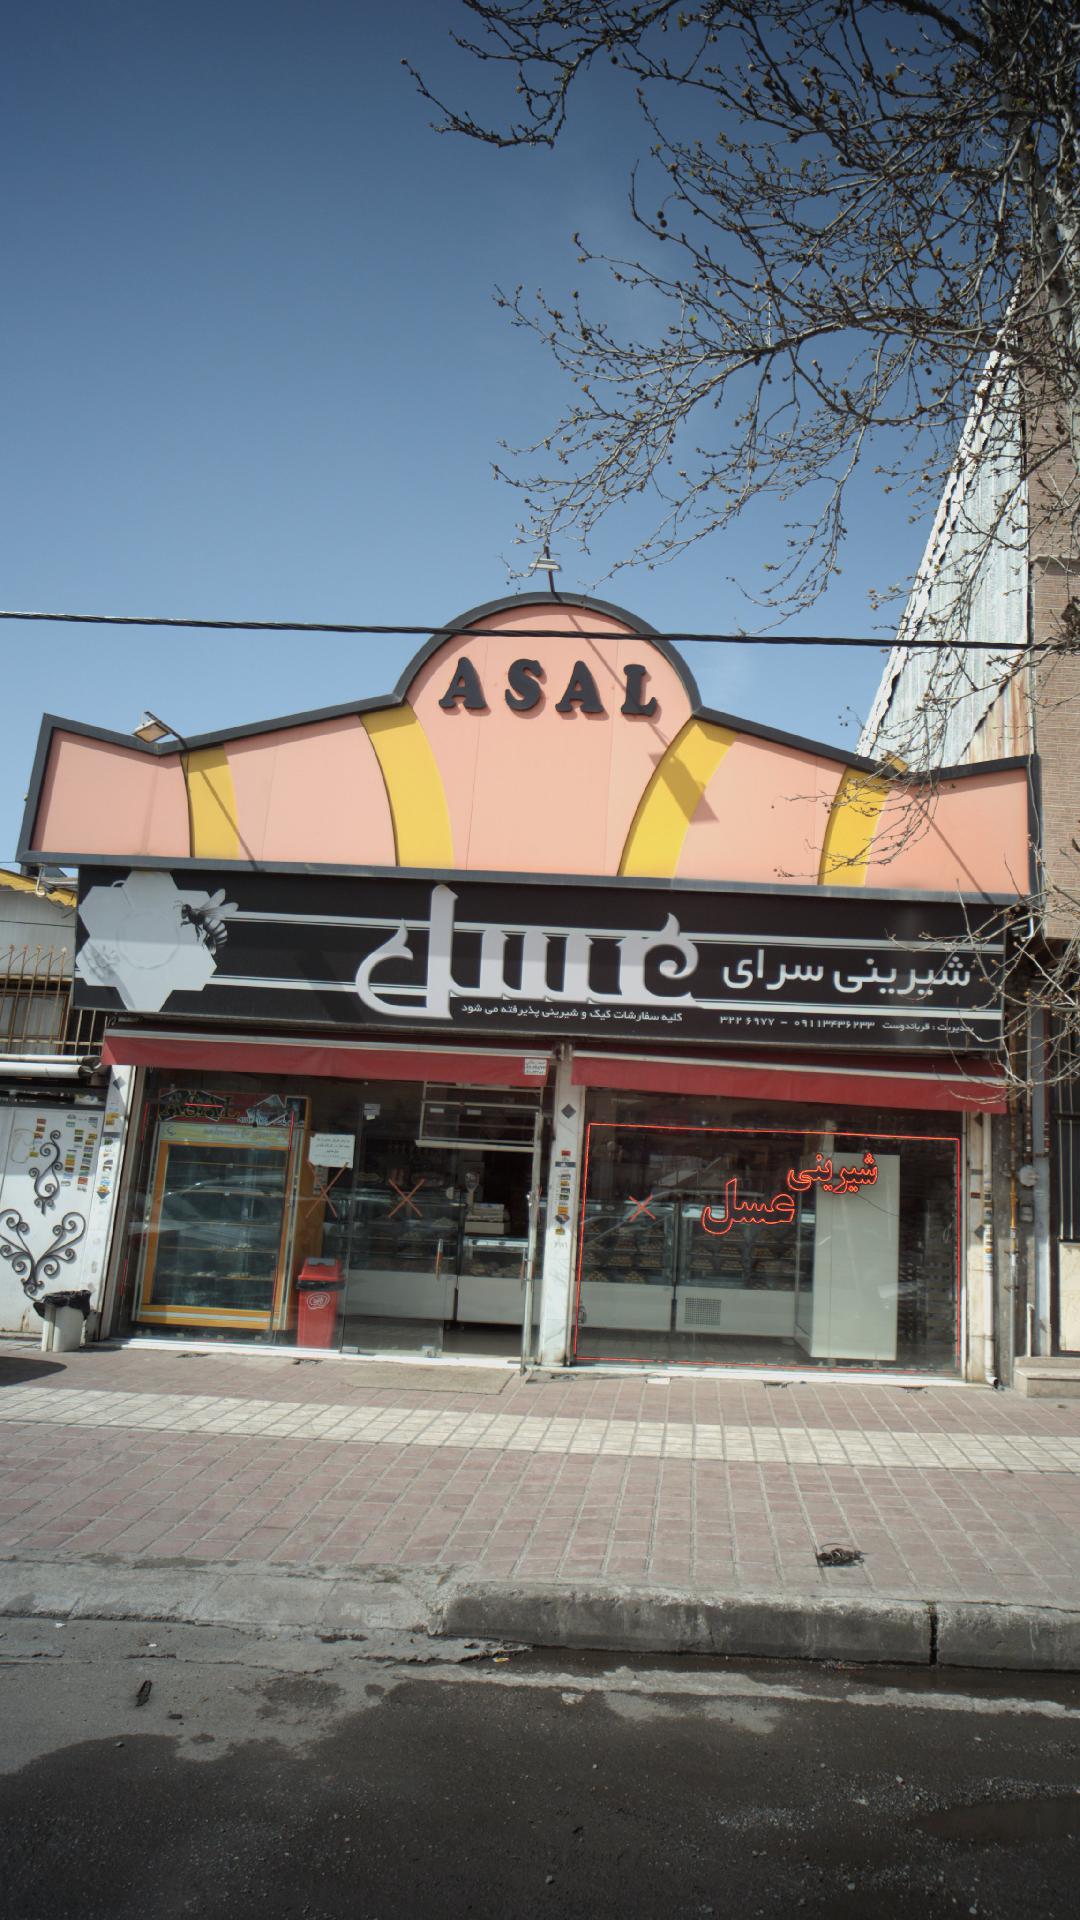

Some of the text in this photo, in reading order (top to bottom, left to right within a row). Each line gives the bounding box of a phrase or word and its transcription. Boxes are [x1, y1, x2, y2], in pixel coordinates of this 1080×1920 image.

[438, 656, 658, 717] ASAL
[355, 884, 971, 1020] شیرینی سرای عسل
[501, 1004, 540, 1018] پذیرفته
[541, 1007, 579, 1019] شیرینی
[580, 1011, 587, 1020] و
[589, 1010, 612, 1021] کیک
[613, 1010, 660, 1023] سفارشات
[661, 1012, 683, 1023] کلیه
[786, 1152, 879, 1195] شیرینی
[701, 1177, 796, 1236] عسل
